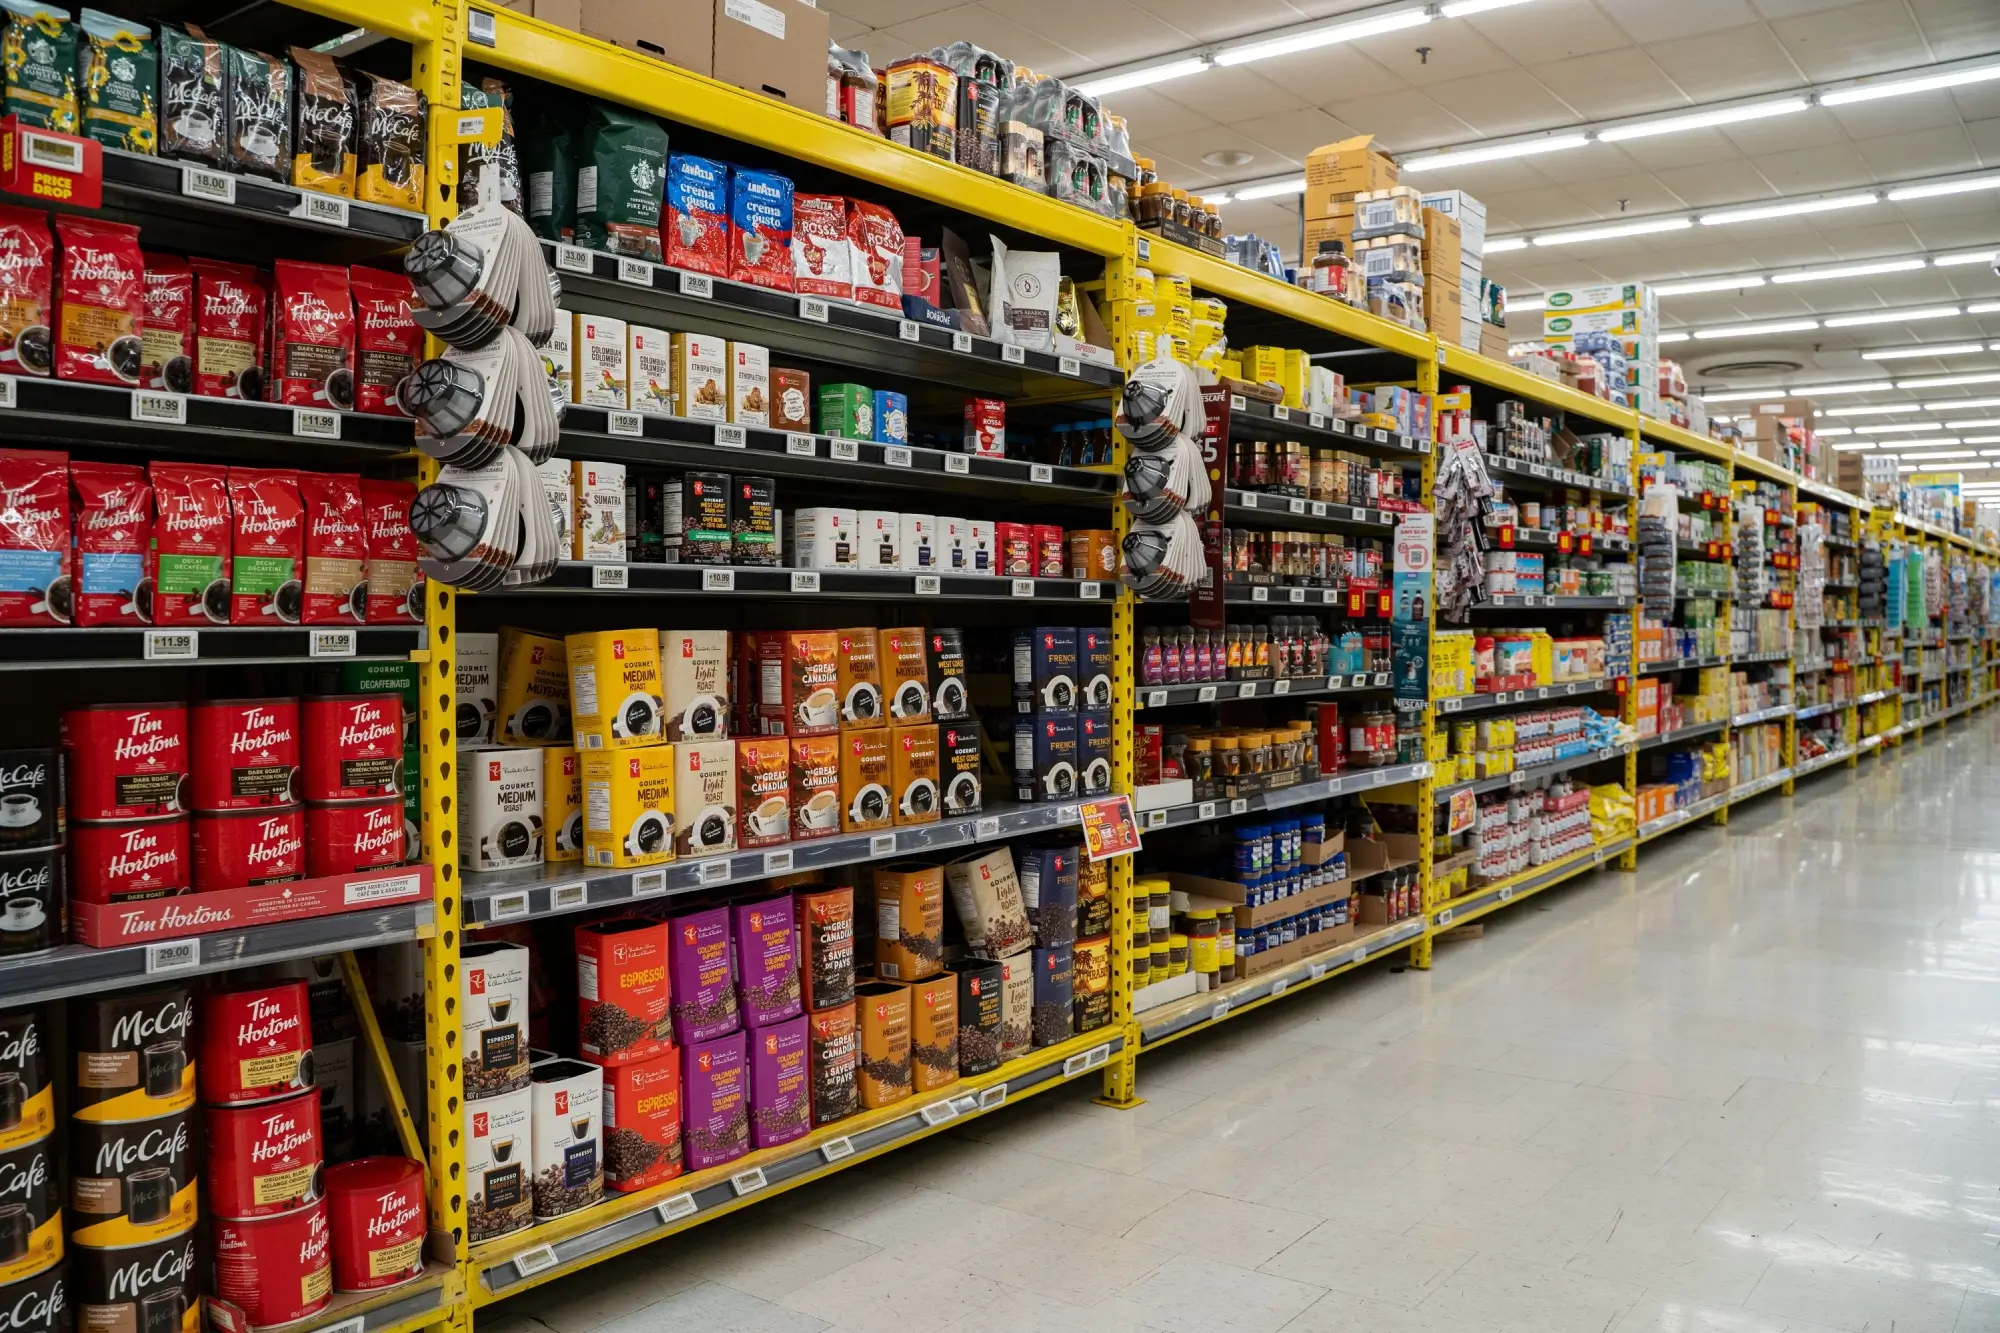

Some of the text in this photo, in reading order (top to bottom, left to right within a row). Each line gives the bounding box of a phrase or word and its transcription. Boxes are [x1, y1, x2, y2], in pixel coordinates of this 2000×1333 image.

[682, 163, 714, 181] LAVAZZA
[33, 172, 72, 189] PRICE
[196, 174, 226, 189] 18.00
[33, 183, 72, 199] DROP
[681, 183, 714, 200] crema
[748, 182, 781, 198] LAVAZZA
[313, 199, 340, 214] 18.00
[642, 204, 658, 213] PLACE
[747, 201, 780, 217] crema
[803, 222, 838, 238] ROSSA
[869, 232, 898, 250] ROSSA
[565, 251, 586, 263] 33.00
[627, 262, 646, 275] 26.99
[688, 276, 706, 288] 29.00
[204, 296, 258, 316] Hortons
[807, 304, 823, 313] 29.00
[364, 314, 415, 329] Hortons
[926, 309, 951, 325] BORBONE
[554, 341, 568, 352] RICA
[591, 346, 622, 356] COLOMBIAN
[591, 353, 622, 364] COLOMBIEN
[640, 363, 666, 374] COLOMBIEN
[148, 399, 178, 412] 11.99
[308, 416, 334, 426] 11.99
[619, 416, 638, 426] 10.99
[983, 418, 1001, 426] ROSSA
[725, 429, 741, 439] 10.99
[797, 438, 810, 447] 8.99
[554, 492, 568, 502] RICA
[594, 494, 621, 506] SUMATRA
[379, 504, 403, 520] Tim
[88, 510, 145, 530] Hortons
[166, 512, 225, 532] Hortons
[240, 516, 297, 535] Hortons
[313, 519, 360, 536] Hortons
[604, 569, 623, 579] 10.99
[713, 574, 730, 582] 10.99
[161, 635, 190, 648] 11.99
[324, 635, 349, 645] 11.99
[1048, 654, 1076, 662] FRENCH
[1091, 653, 1112, 662] FRENCH
[367, 666, 404, 674] GOURMET
[624, 661, 654, 669] GOURMET
[813, 663, 835, 673] GREAT
[849, 661, 876, 673] MEDIUM
[623, 669, 656, 684] MEDIUM
[695, 665, 717, 682] Light
[802, 673, 837, 684] CANADIAN
[896, 666, 925, 678] MOYENNE
[360, 678, 410, 690] DECAFFEINATED
[629, 683, 646, 691] ROAST
[696, 681, 715, 691] ROAST
[242, 707, 274, 730] Tim
[350, 702, 380, 724] Tim
[127, 712, 162, 736] Tim
[339, 722, 396, 747] Hortons
[115, 734, 180, 761] Hortons
[231, 729, 292, 754] Hortons
[1050, 740, 1076, 750] FRENCH
[1088, 737, 1111, 746] FRENCH
[910, 758, 936, 770] MEDIUM
[951, 754, 980, 764] WEST COAST
[247, 768, 263, 776] DARK
[699, 770, 728, 778] GOURMET
[813, 765, 836, 776] GREAT
[860, 763, 888, 775] MEDIUM
[639, 778, 668, 787] GOURMET
[762, 770, 786, 782] GREAT
[802, 775, 838, 788] CANADIAN
[499, 781, 535, 790] GOURMET
[702, 777, 725, 793] Light
[751, 780, 788, 793] CANADIAN
[497, 790, 536, 805] MEDIUM
[637, 786, 670, 802] MEDIUM
[704, 792, 723, 802] ROAST
[503, 804, 523, 812] ROAST
[643, 800, 659, 809] ROAST
[1082, 804, 1097, 815] BIG
[364, 808, 391, 831] Tim
[1085, 816, 1103, 826] DEALS
[259, 817, 289, 840] Tim
[120, 828, 157, 853] Tim
[354, 826, 403, 854] Hortons
[248, 836, 302, 865] Hortons
[108, 849, 177, 879] Hortons
[264, 876, 295, 886] DARK ROAST
[990, 871, 1015, 887] GOURMET
[127, 890, 165, 901] DARK ROAST
[996, 883, 1016, 901] Light
[258, 899, 285, 907] ROASTING
[1001, 896, 1018, 911] ROAST
[120, 905, 232, 936] Tim Hortons
[831, 918, 852, 932] GREAT
[762, 928, 790, 941] COLOMBIAN
[820, 928, 854, 944] CANADIAN
[697, 940, 727, 955] COLOMBIAN
[766, 937, 787, 947] SUPREMO
[159, 946, 189, 959] 29.00
[702, 950, 723, 961] SUPREMO
[1091, 956, 1106, 964] PRIDE
[620, 966, 665, 989] ESPRESSO
[699, 966, 728, 980] COLOMBIEN
[1011, 987, 1028, 1004] Light
[247, 997, 280, 1021] Tim
[1012, 1001, 1028, 1014] ROAST
[111, 996, 193, 1048] McCafé
[237, 1014, 300, 1046] Hortons
[486, 1033, 515, 1044] ESPRESSO
[487, 1040, 515, 1050] PERFETTO
[776, 1050, 804, 1064] COLOMBIAN
[822, 1043, 856, 1060] CANADIAN
[249, 1054, 295, 1067] ORIGINAL BLEND
[710, 1067, 741, 1082] COLOMBIAN
[637, 1090, 678, 1113] ESPRESSO
[262, 1113, 295, 1138] Tim
[96, 1121, 188, 1174] McCafé
[252, 1128, 313, 1163] Hortons
[569, 1148, 593, 1160] ESPRESSO
[263, 1168, 308, 1184] ORIGINAL BLEND
[489, 1173, 517, 1185] ESPRESSO
[377, 1191, 406, 1215] Tim
[367, 1202, 421, 1238] Hortons
[109, 1239, 195, 1300] McCafé
